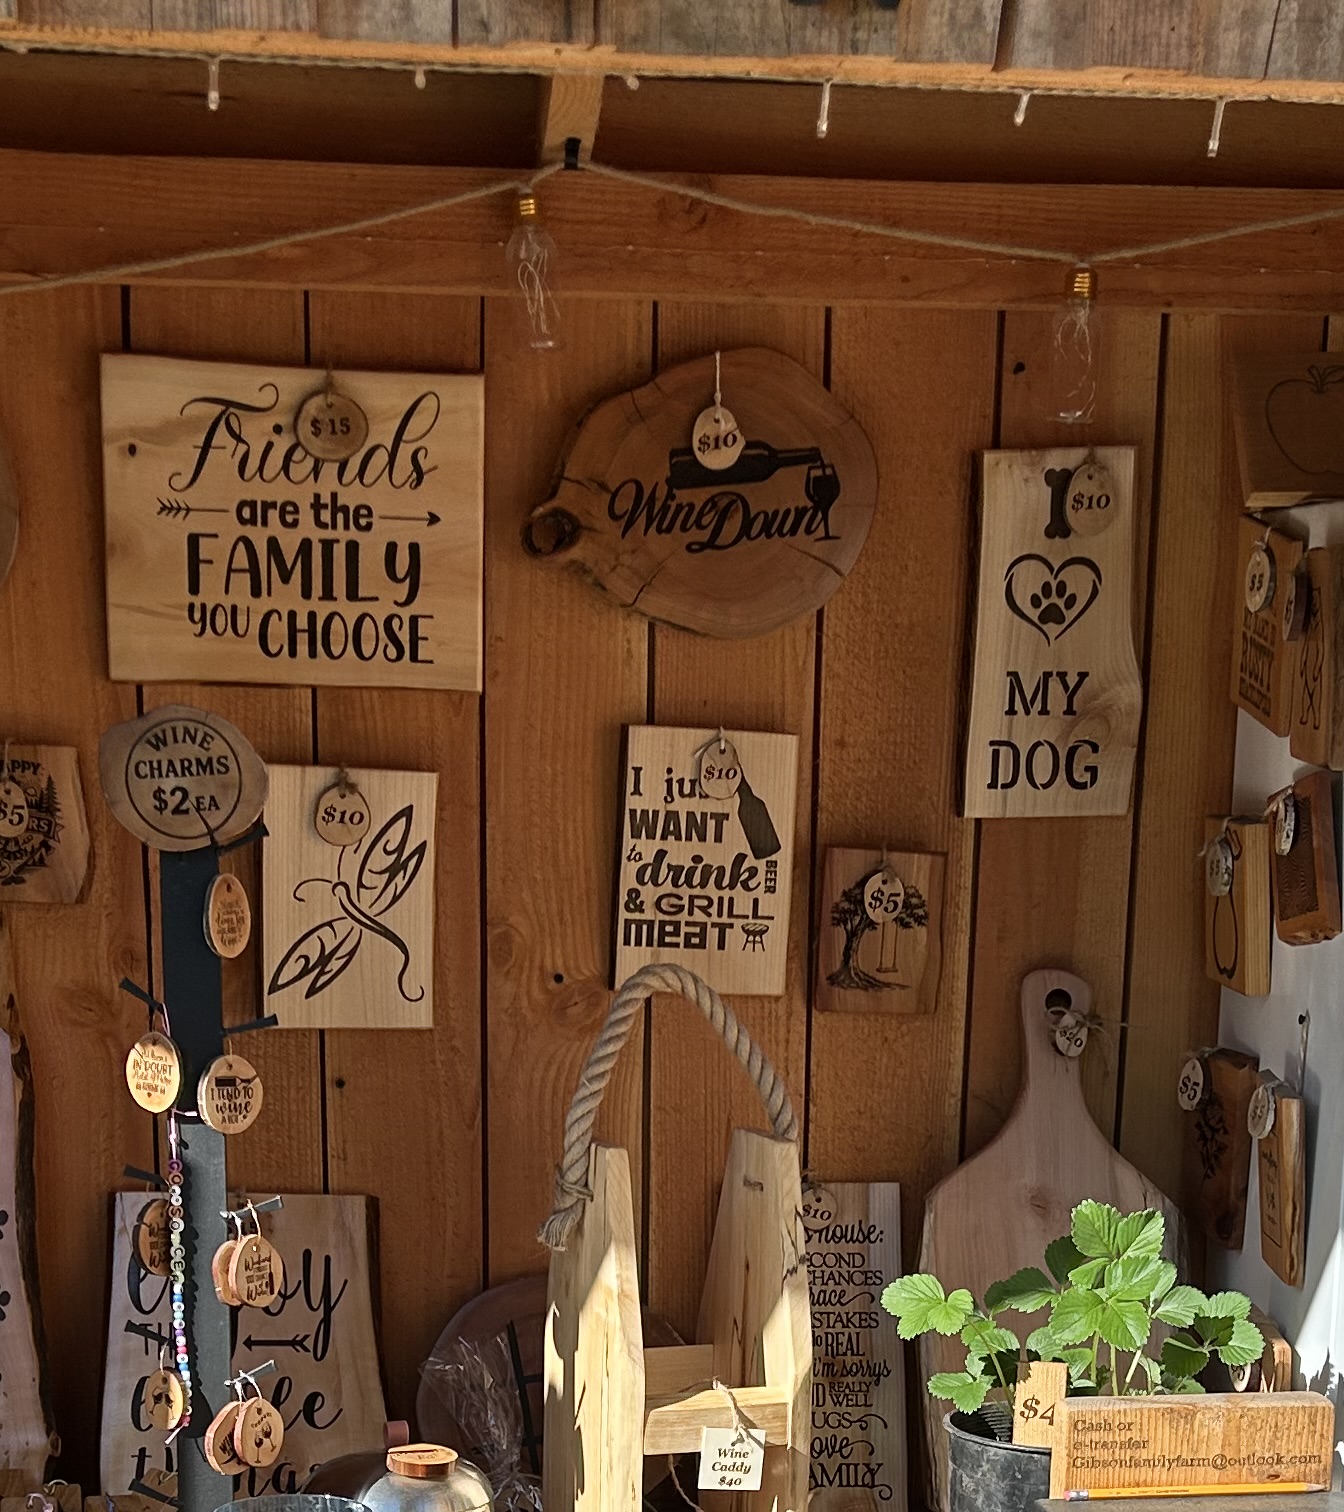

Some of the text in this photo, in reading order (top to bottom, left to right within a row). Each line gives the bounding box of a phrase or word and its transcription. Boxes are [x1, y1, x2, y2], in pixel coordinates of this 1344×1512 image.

[310, 418, 351, 438] $15
[697, 431, 738, 455] $10
[235, 491, 374, 532] are the
[1071, 492, 1111, 513] $10
[187, 532, 421, 608] FAMILY
[258, 609, 434, 664] CHOOSE
[1005, 671, 1089, 716] MY
[145, 725, 215, 752] WINE
[134, 756, 230, 780] CHARMS
[703, 764, 738, 781] $10
[987, 739, 1100, 790] DOG
[630, 766, 643, 797] I
[151, 786, 221, 817] $2 EA
[321, 805, 365, 826] $10
[629, 808, 730, 843] WANT
[626, 843, 761, 892] to drink
[763, 859, 778, 895] BEER
[624, 887, 775, 921] & GRILL
[868, 887, 901, 915] $5
[1179, 1074, 1200, 1102] $5
[802, 1204, 832, 1221] $10
[808, 1270, 884, 1287] HANCES
[824, 1331, 865, 1360] REAL
[839, 1359, 892, 1387] sorrys
[828, 1381, 873, 1393] REALLY
[828, 1394, 874, 1408] WELL
[1073, 1418, 1135, 1433] Cash or
[717, 1447, 750, 1459] Wine
[1071, 1452, 1323, 1471] Gibsonfamilyfarm@outlook.com
[711, 1461, 752, 1475] Caddy
[717, 1475, 743, 1488] $40
